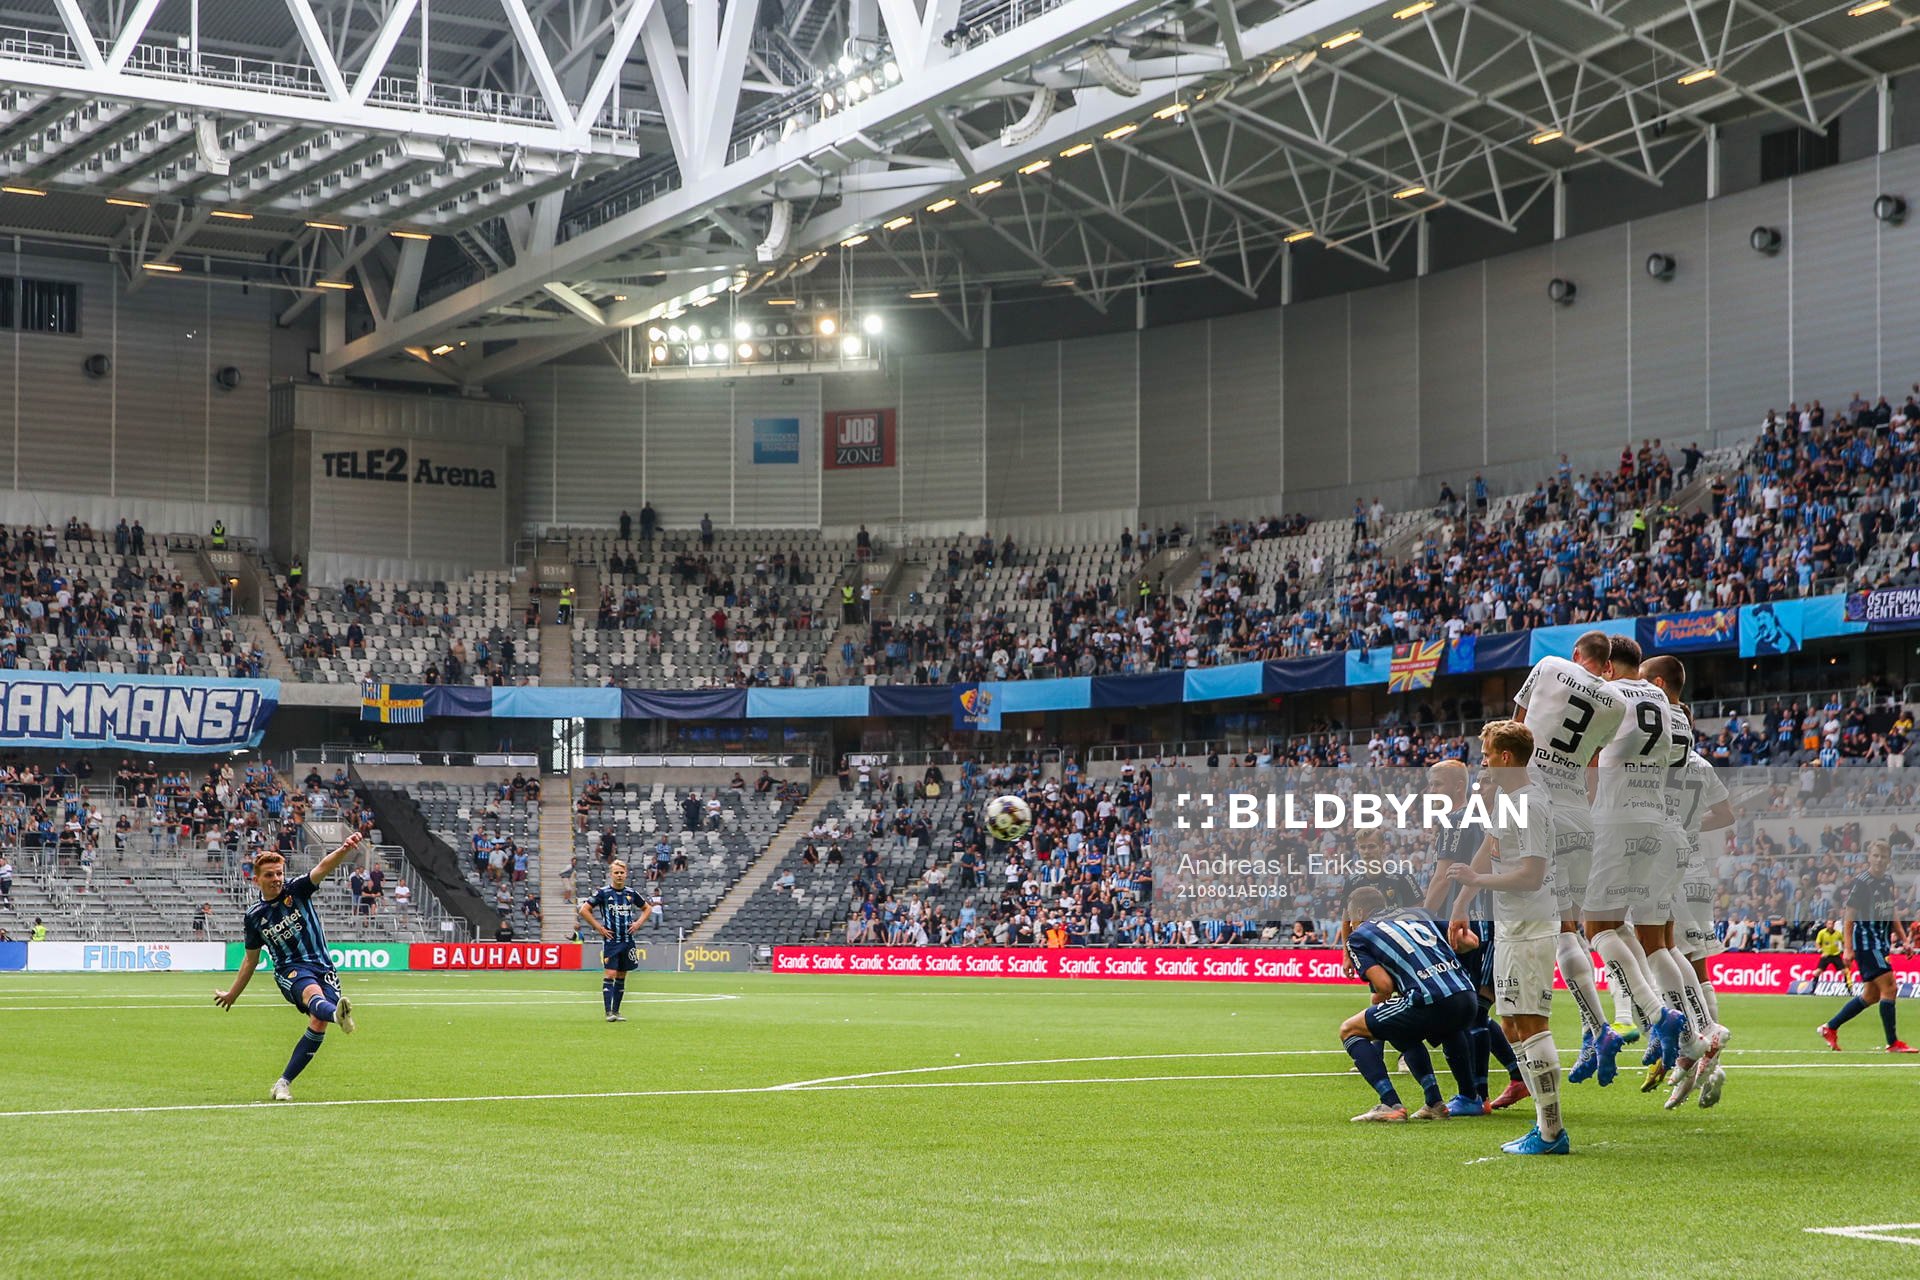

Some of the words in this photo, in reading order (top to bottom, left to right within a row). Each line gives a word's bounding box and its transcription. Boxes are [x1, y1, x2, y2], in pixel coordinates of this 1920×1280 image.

[840, 418, 876, 444] JOB
[322, 448, 408, 482] TELE2
[413, 458, 496, 489] Arena
[836, 447, 881, 464] ZONE
[1556, 672, 1614, 708] Glimstedt
[1549, 695, 1595, 754] 3
[1636, 701, 1663, 756] 9
[262, 908, 302, 938] Prioritet
[1376, 912, 1438, 954] 16
[83, 945, 172, 969] Flinks
[433, 946, 558, 965] BAUHAUS
[684, 947, 730, 970] gibon
[778, 953, 809, 969] Scandic
[813, 953, 845, 970] Scandic
[850, 954, 884, 970] Scandic
[887, 954, 922, 971] Scandic
[926, 955, 962, 972] Scandic
[966, 955, 1003, 972] Scandic
[1008, 956, 1048, 973] Scandic
[1059, 956, 1100, 974] Scandic
[1105, 956, 1148, 975] Scandic
[1155, 957, 1198, 975] Scandic
[1203, 957, 1249, 976] Scandic
[1254, 958, 1303, 977] Scandic
[1309, 959, 1350, 978] Scan
[1712, 964, 1781, 986] Scandic
